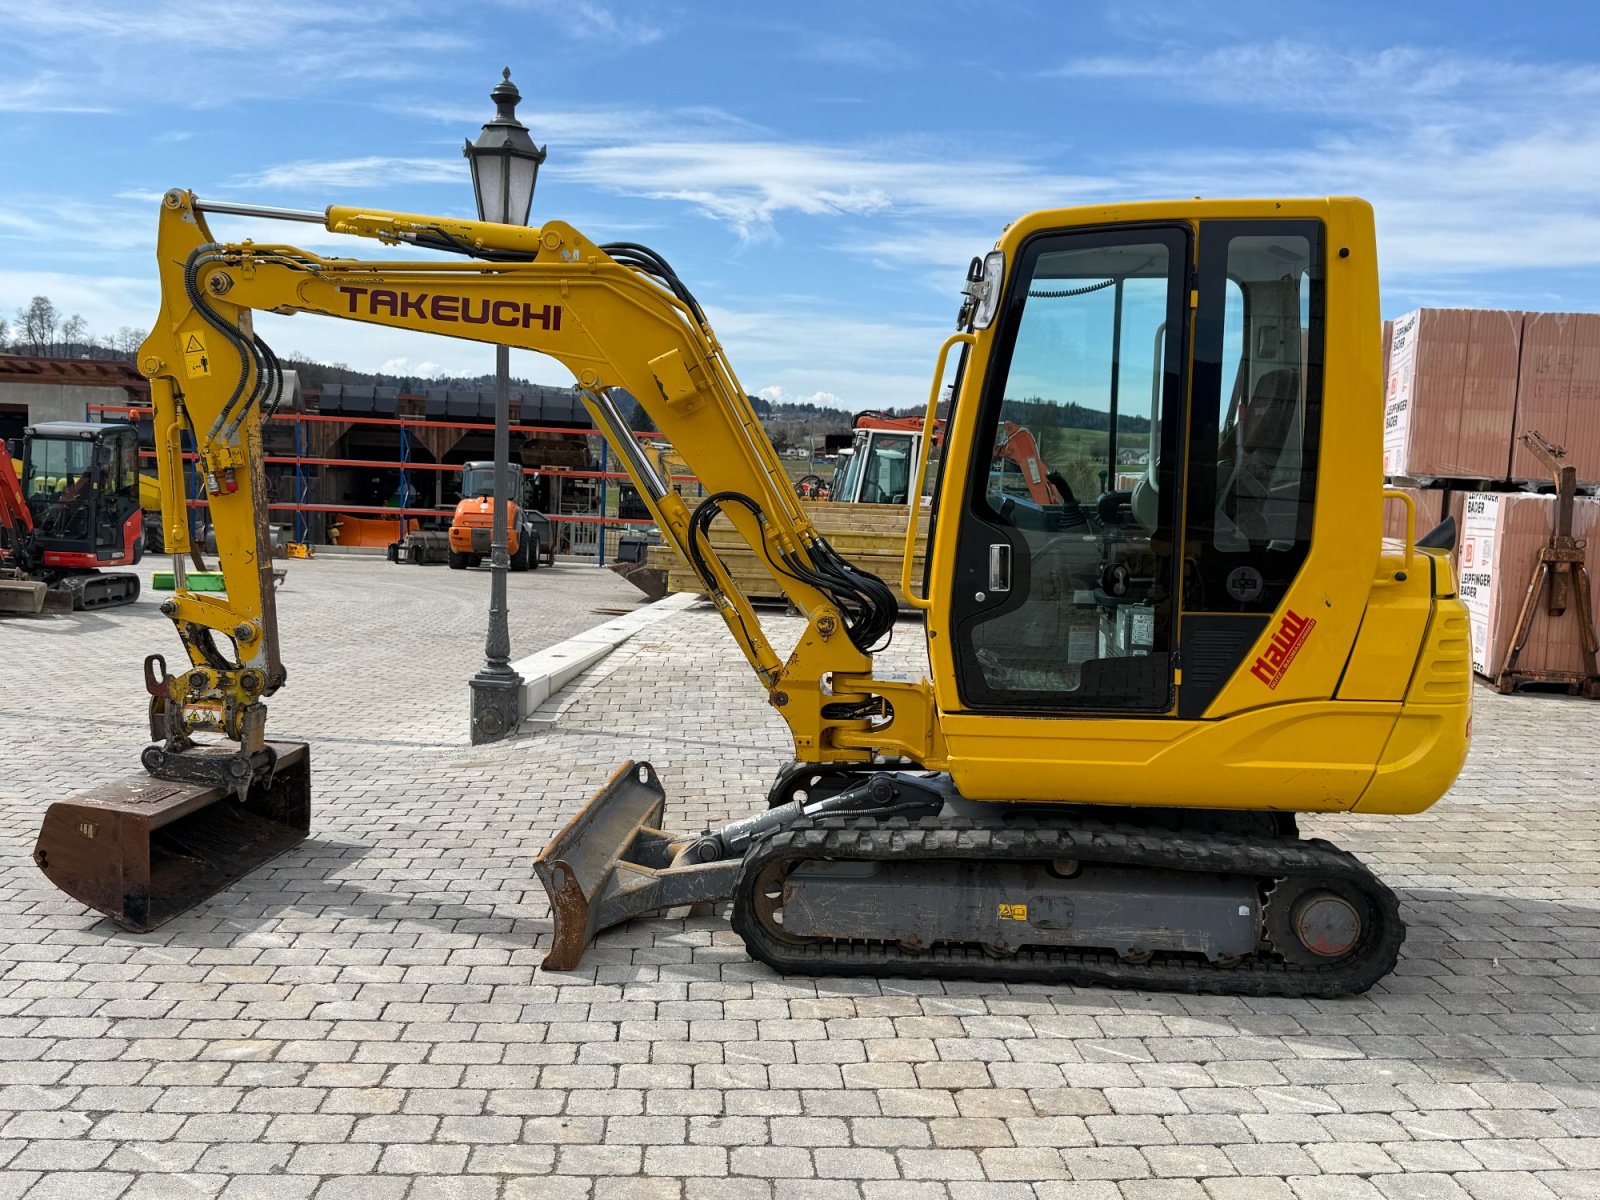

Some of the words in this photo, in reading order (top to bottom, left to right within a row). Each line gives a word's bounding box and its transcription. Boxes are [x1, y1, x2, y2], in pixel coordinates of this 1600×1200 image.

[339, 286, 563, 331] TAKEUCHI
[1387, 399, 1408, 416] LEIPFINGER
[1385, 415, 1398, 429] BADER
[1467, 501, 1485, 514] BADER
[1461, 572, 1491, 587] LEIPFINGER
[1460, 585, 1477, 599] BADER
